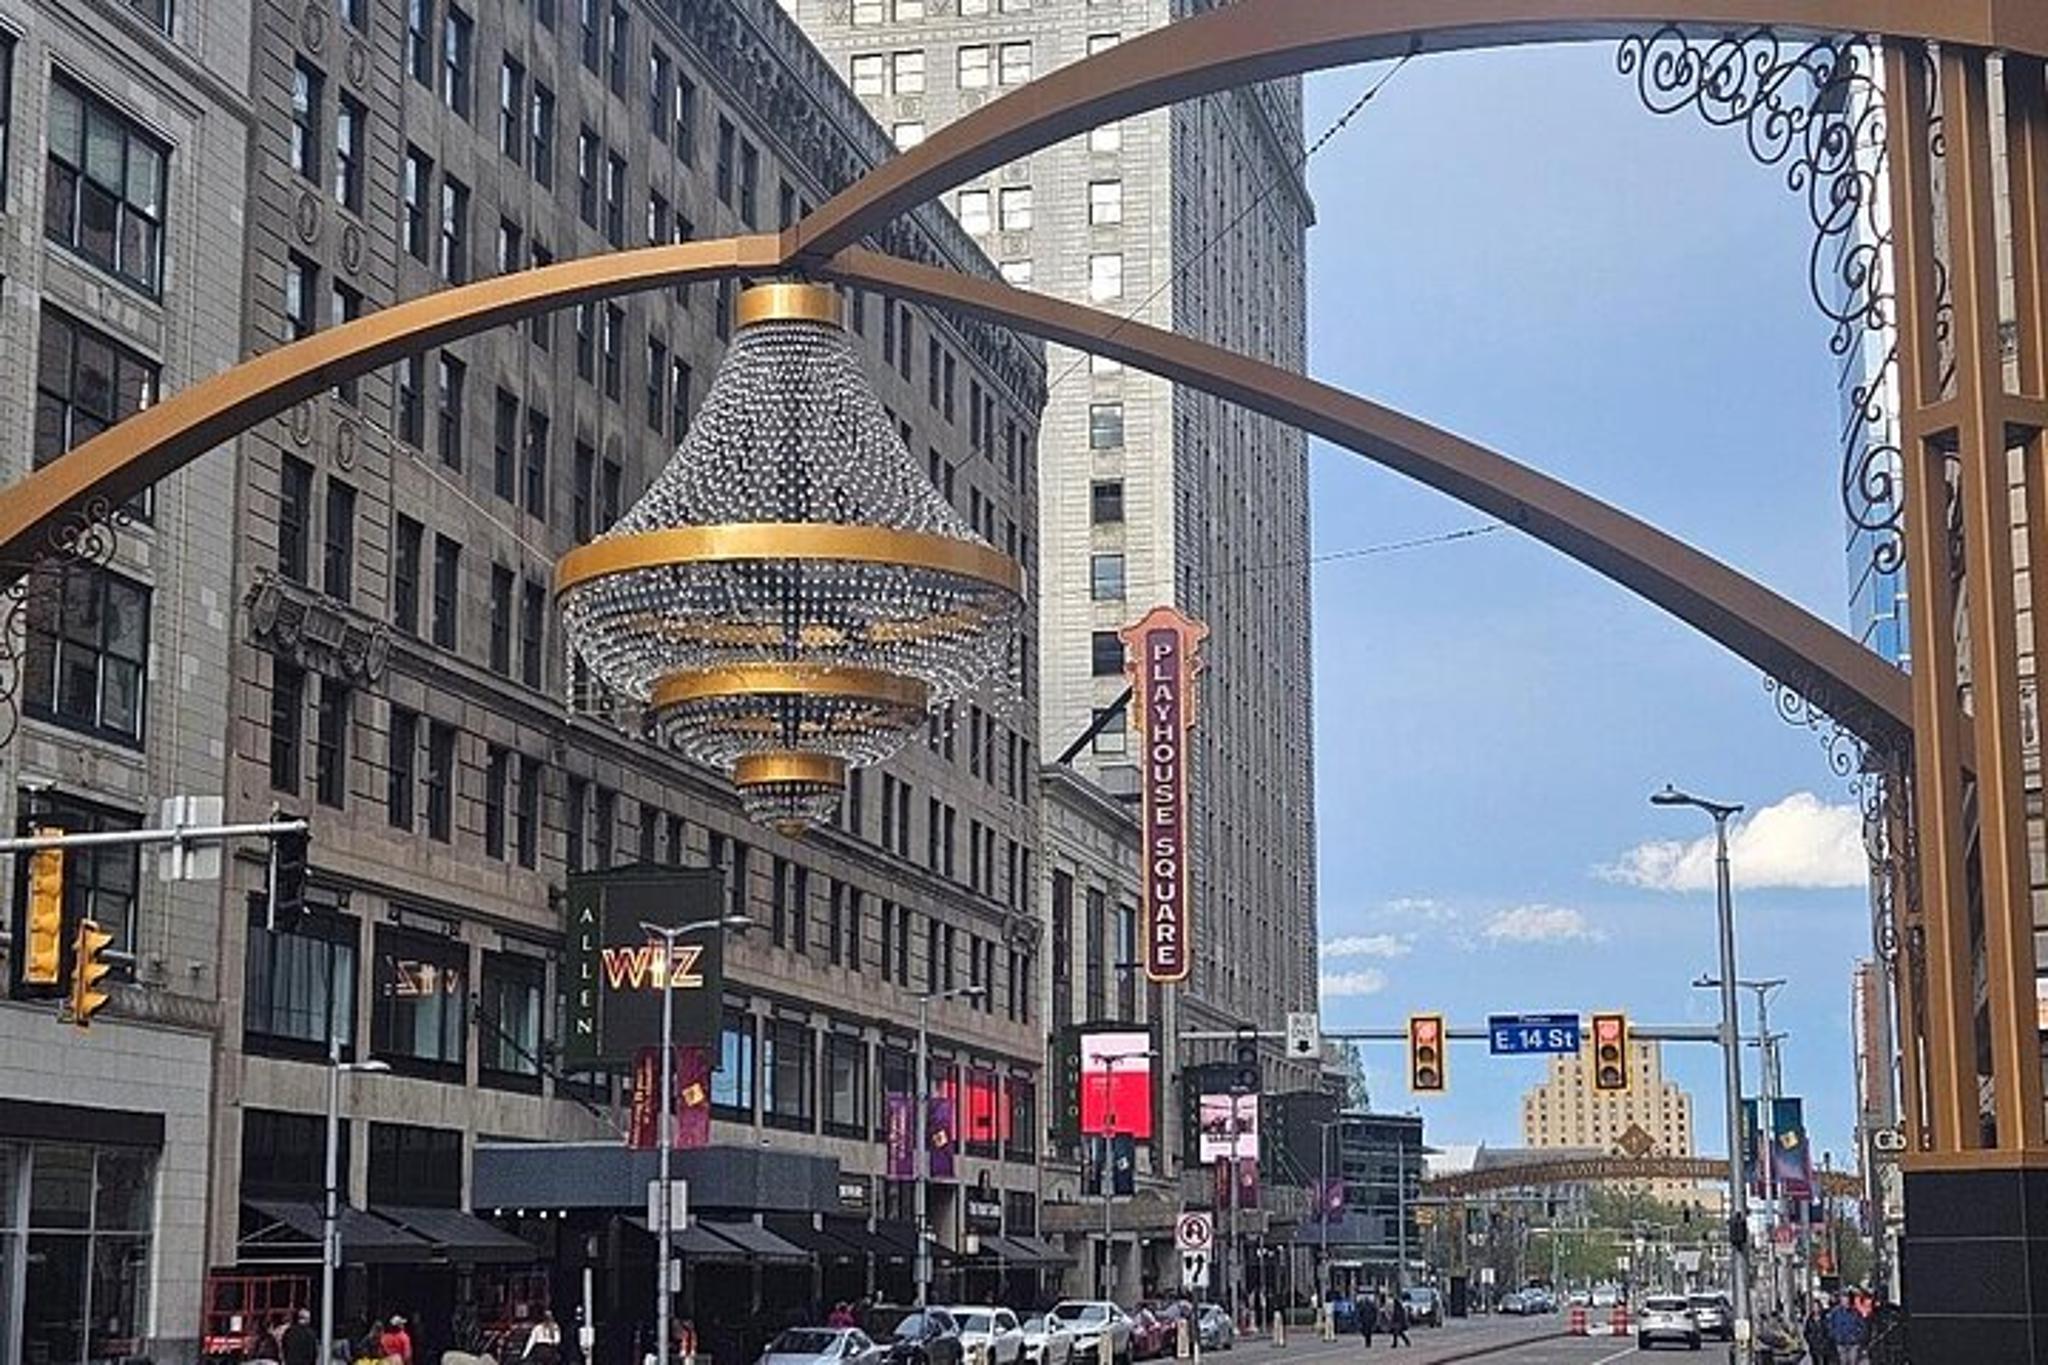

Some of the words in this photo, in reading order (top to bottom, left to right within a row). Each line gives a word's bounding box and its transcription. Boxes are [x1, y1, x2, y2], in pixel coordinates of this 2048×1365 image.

[1153, 644, 1175, 824] PLAYHOUSE
[1154, 838, 1176, 965] SQUARE
[577, 907, 594, 1034] ALLEN
[602, 944, 704, 989] WIZ
[1519, 1029, 1544, 1049] 14
[1549, 1029, 1574, 1048] St
